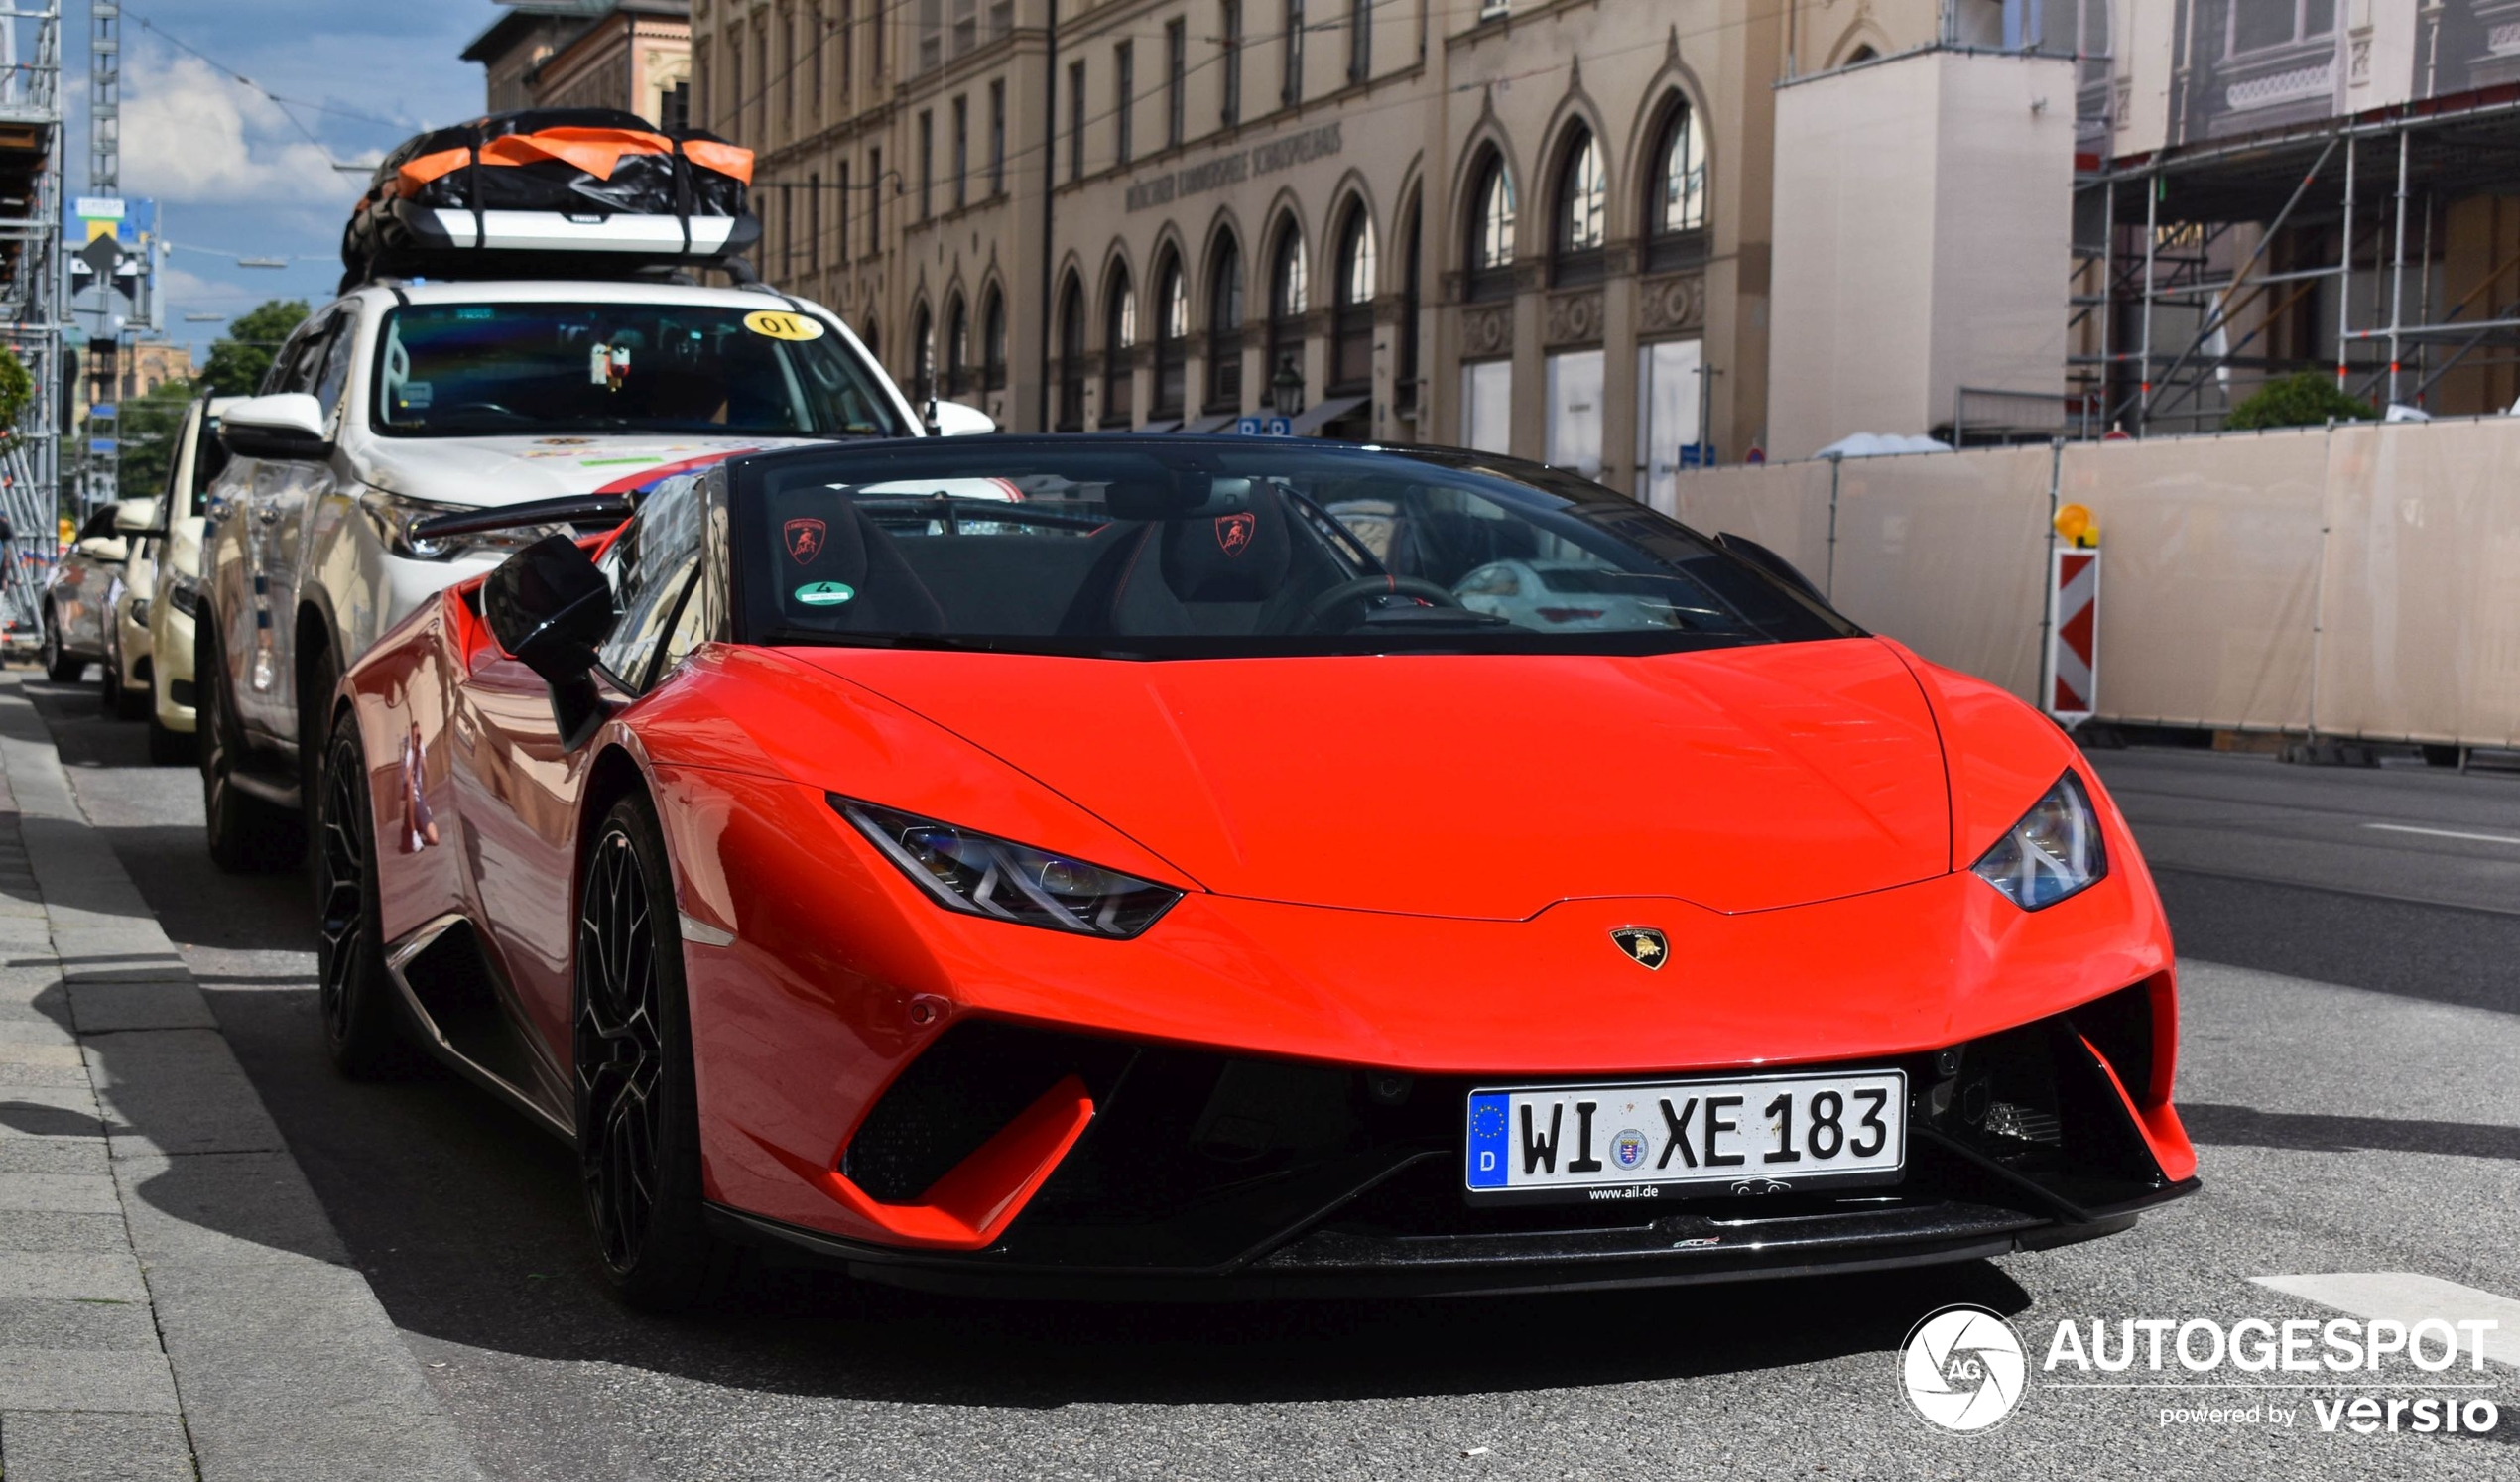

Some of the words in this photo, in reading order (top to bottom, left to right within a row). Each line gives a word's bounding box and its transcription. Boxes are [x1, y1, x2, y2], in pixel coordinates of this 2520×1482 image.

[816, 582, 832, 593] 4
[1519, 1101, 1603, 1174] WI
[1657, 1095, 1745, 1169] XE
[1763, 1087, 1889, 1164] 183
[1480, 1152, 1495, 1171] D
[1589, 1184, 1659, 1200] www.ail.de
